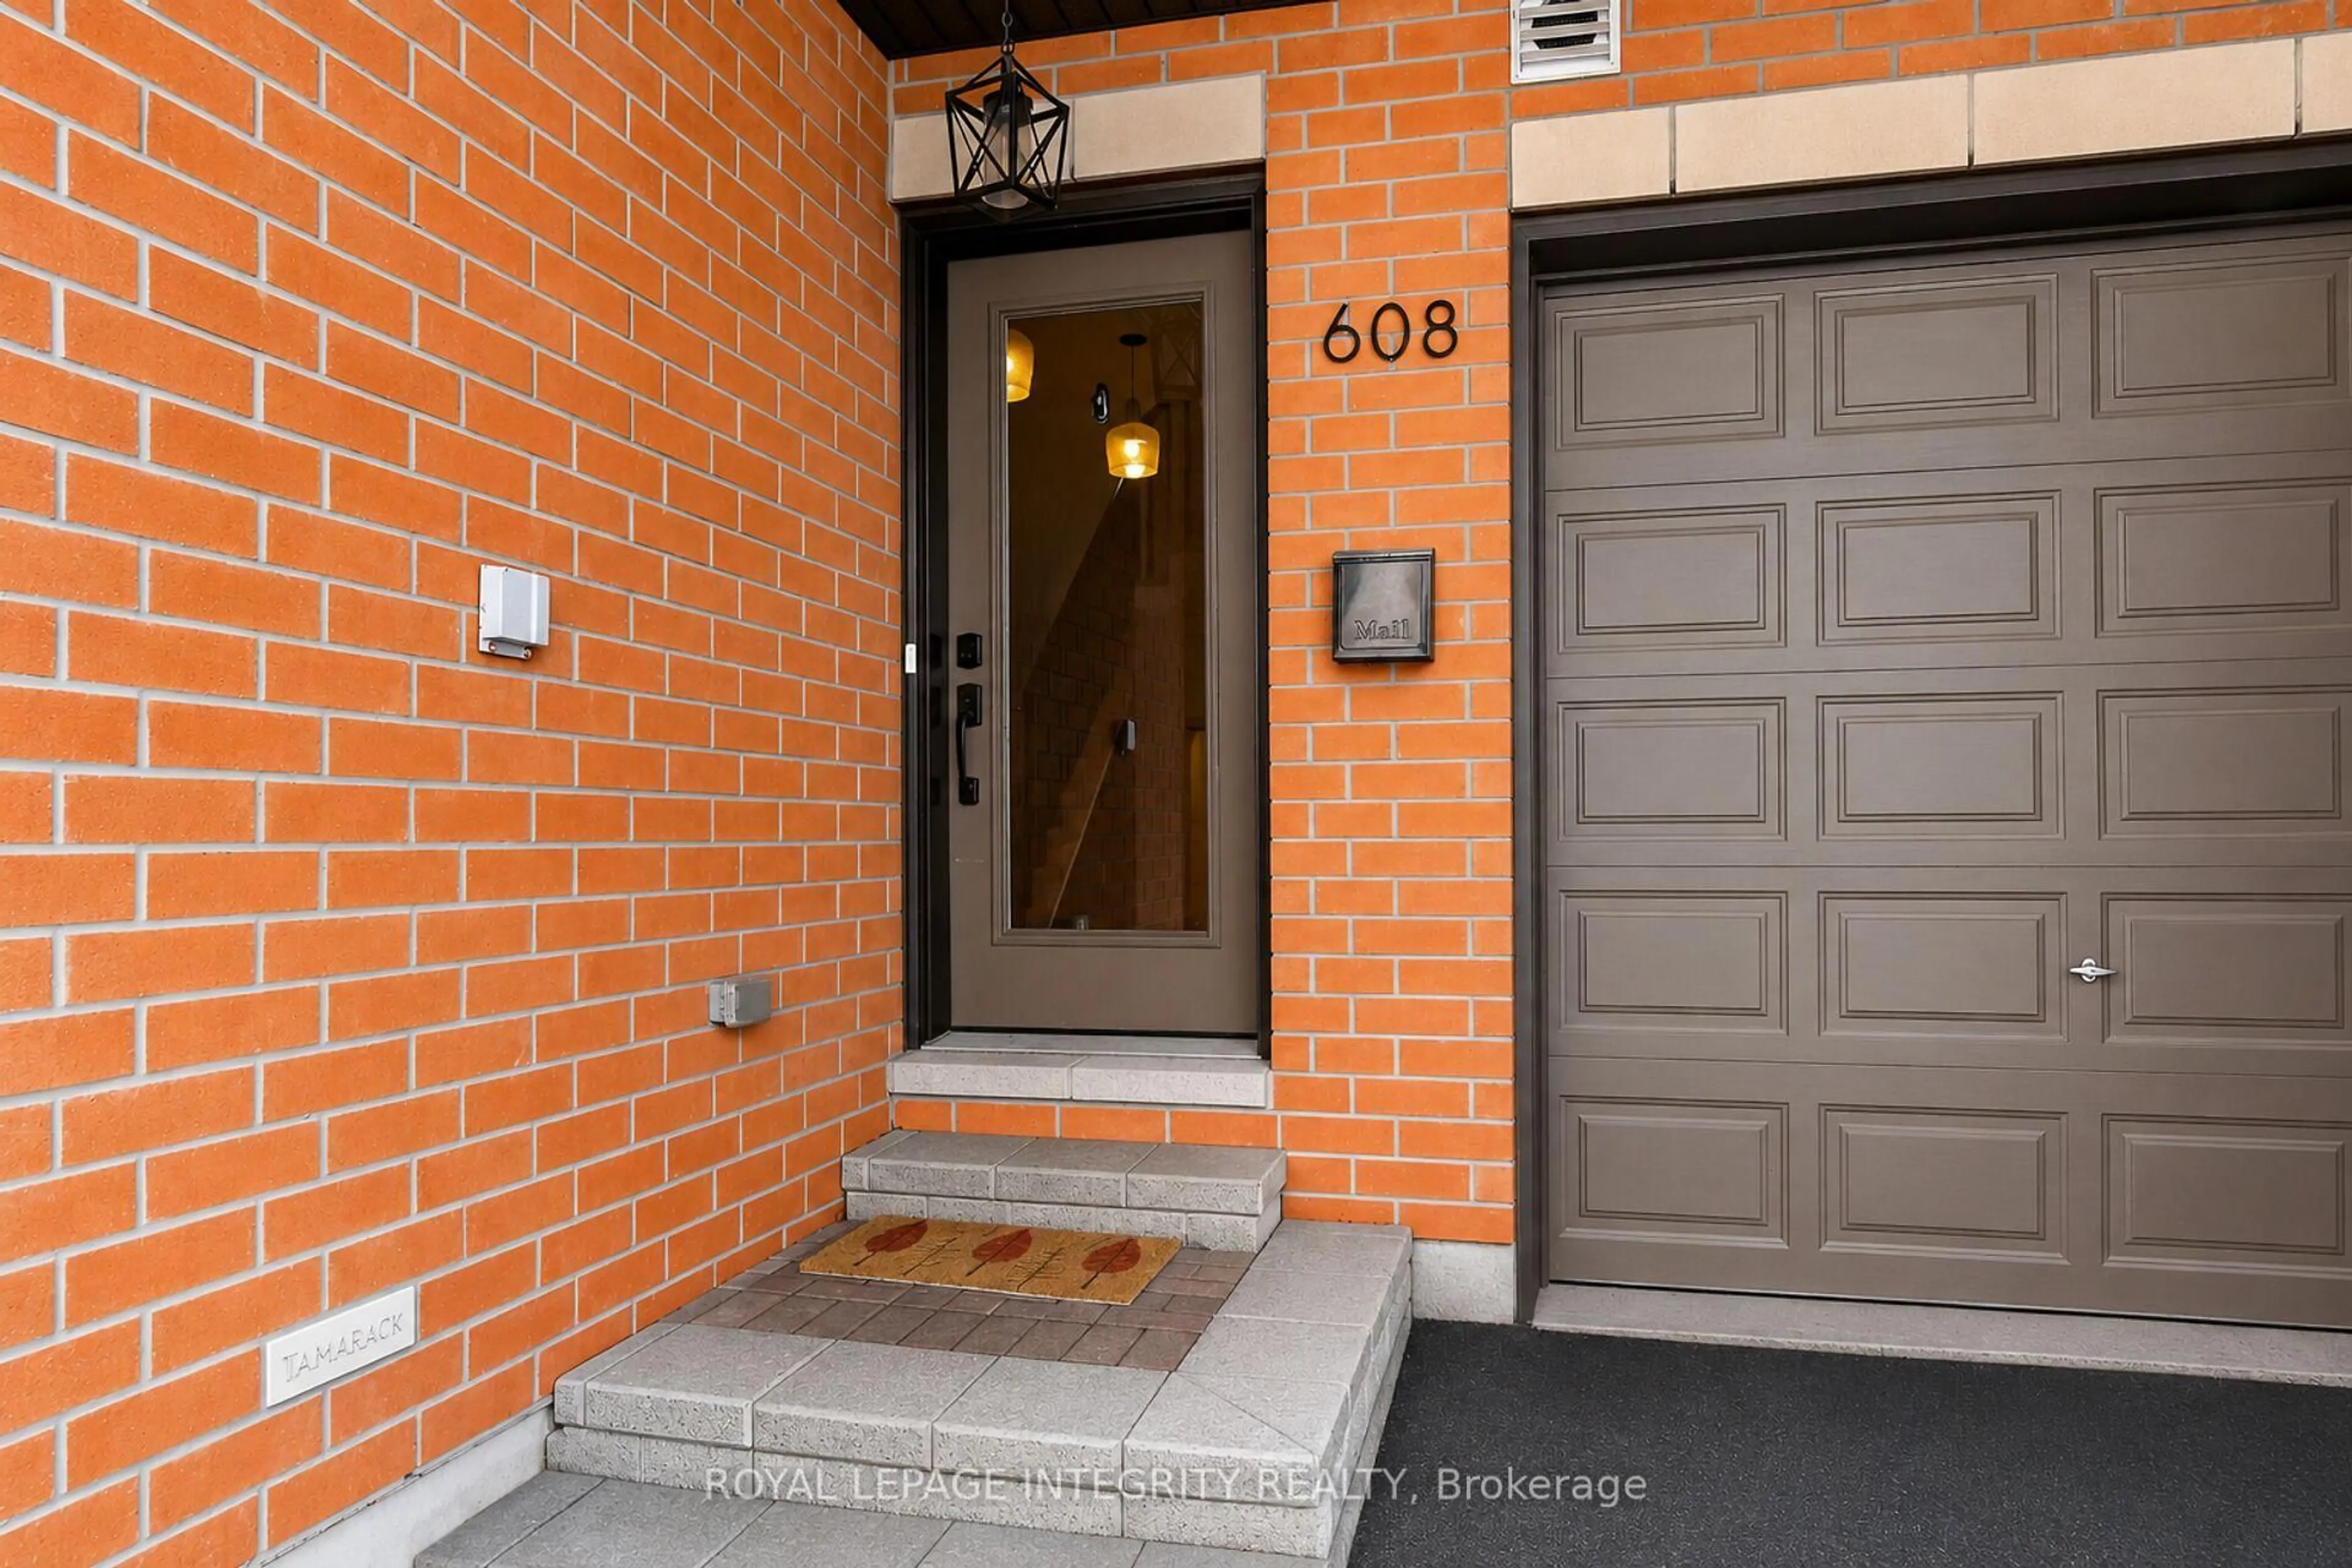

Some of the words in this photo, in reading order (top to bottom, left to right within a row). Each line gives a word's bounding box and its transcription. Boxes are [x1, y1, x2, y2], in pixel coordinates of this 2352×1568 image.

[1323, 300, 1458, 363] 608
[1354, 618, 1411, 640] Mail
[282, 1313, 402, 1382] TAMARACK
